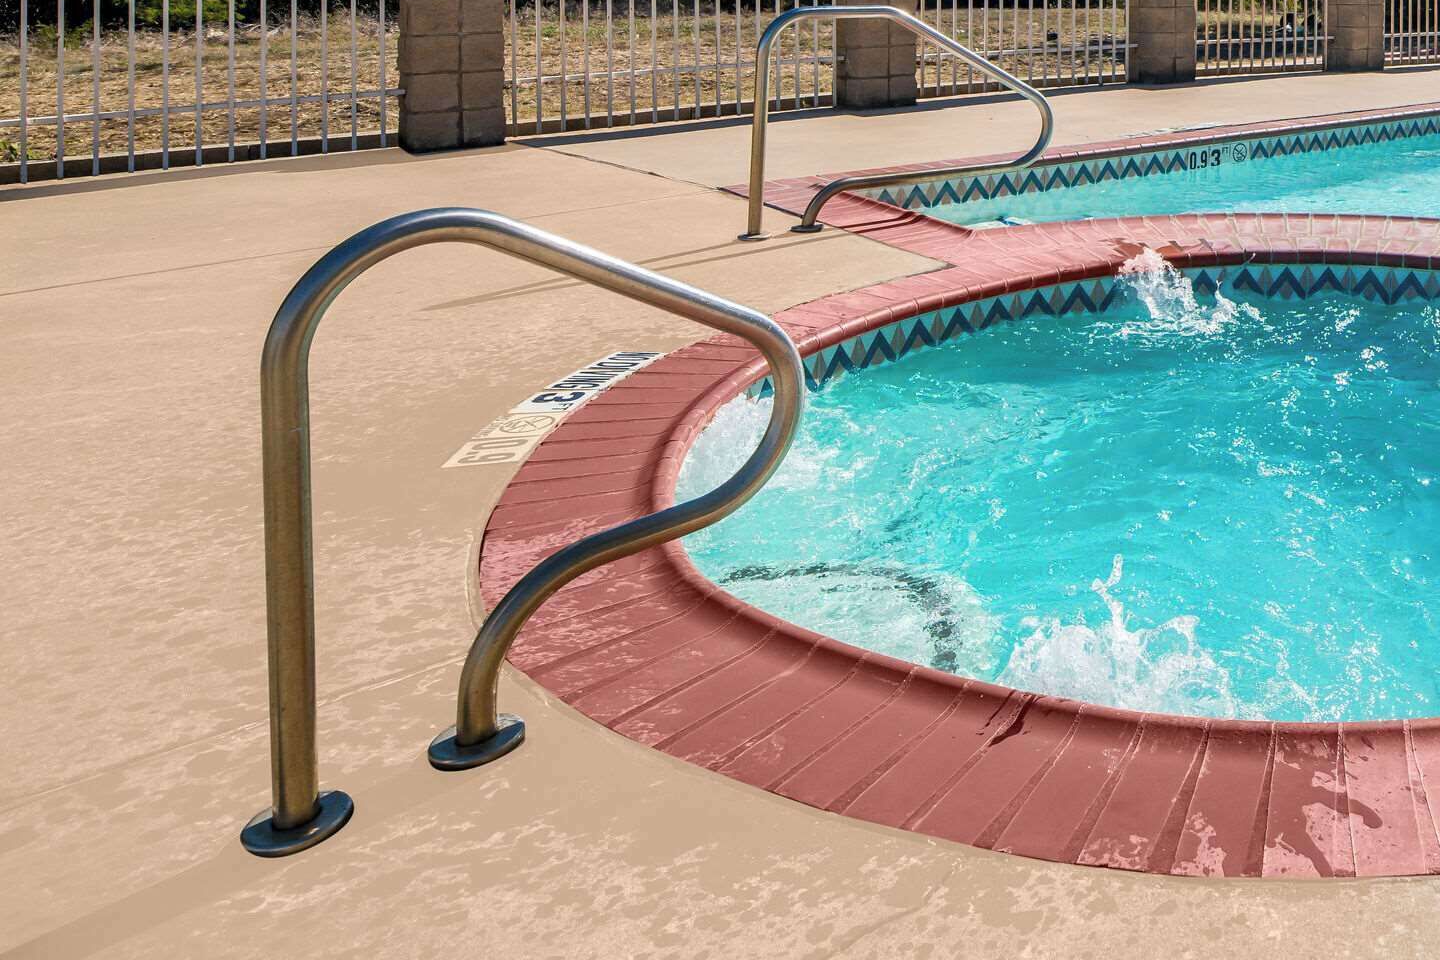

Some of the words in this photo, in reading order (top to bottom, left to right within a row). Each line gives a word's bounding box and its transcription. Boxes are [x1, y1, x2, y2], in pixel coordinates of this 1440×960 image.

[1211, 149, 1220, 166] 3
[550, 361, 640, 389] DIVING
[531, 391, 586, 404] 3
